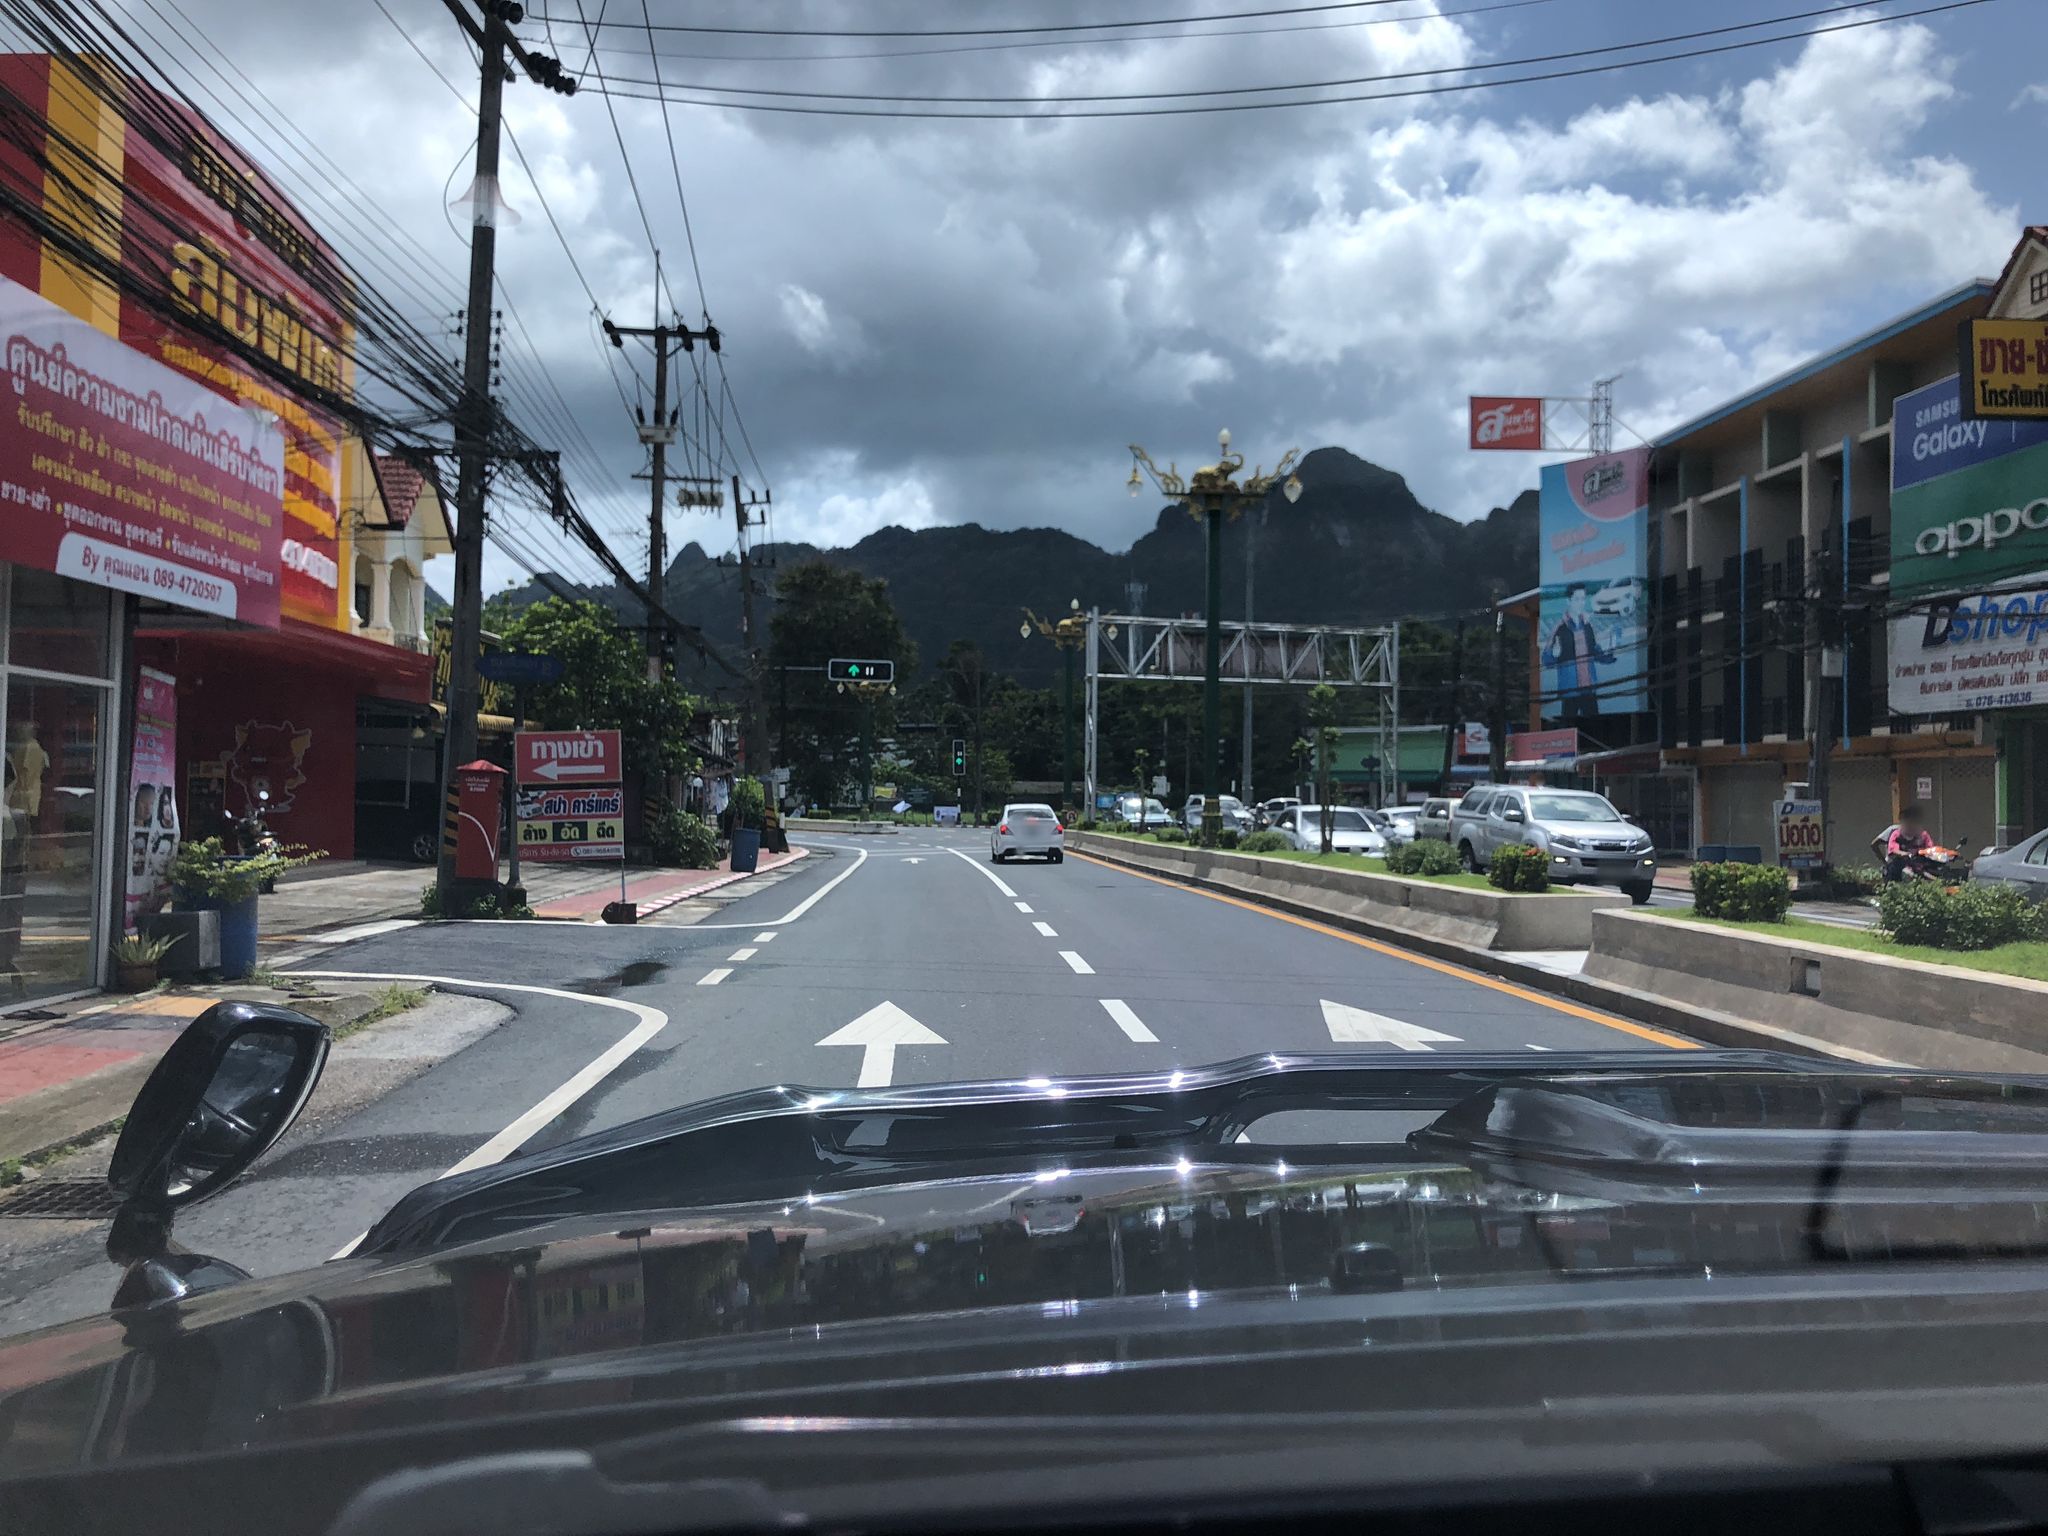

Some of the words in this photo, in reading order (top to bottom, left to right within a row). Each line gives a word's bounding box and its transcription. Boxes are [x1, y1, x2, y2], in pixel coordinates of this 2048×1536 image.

[1912, 419, 1988, 461] Galaxy
[82, 545, 100, 574] By
[153, 565, 223, 603] 089-4720507
[531, 733, 604, 760] ทางเข้า
[543, 795, 568, 816] สปา
[571, 791, 621, 815] คาร์แคร์
[523, 822, 547, 841] ล้าง
[560, 822, 579, 840] อัด
[596, 820, 615, 838] ฉีด
[1779, 815, 1821, 846] มือถือ
